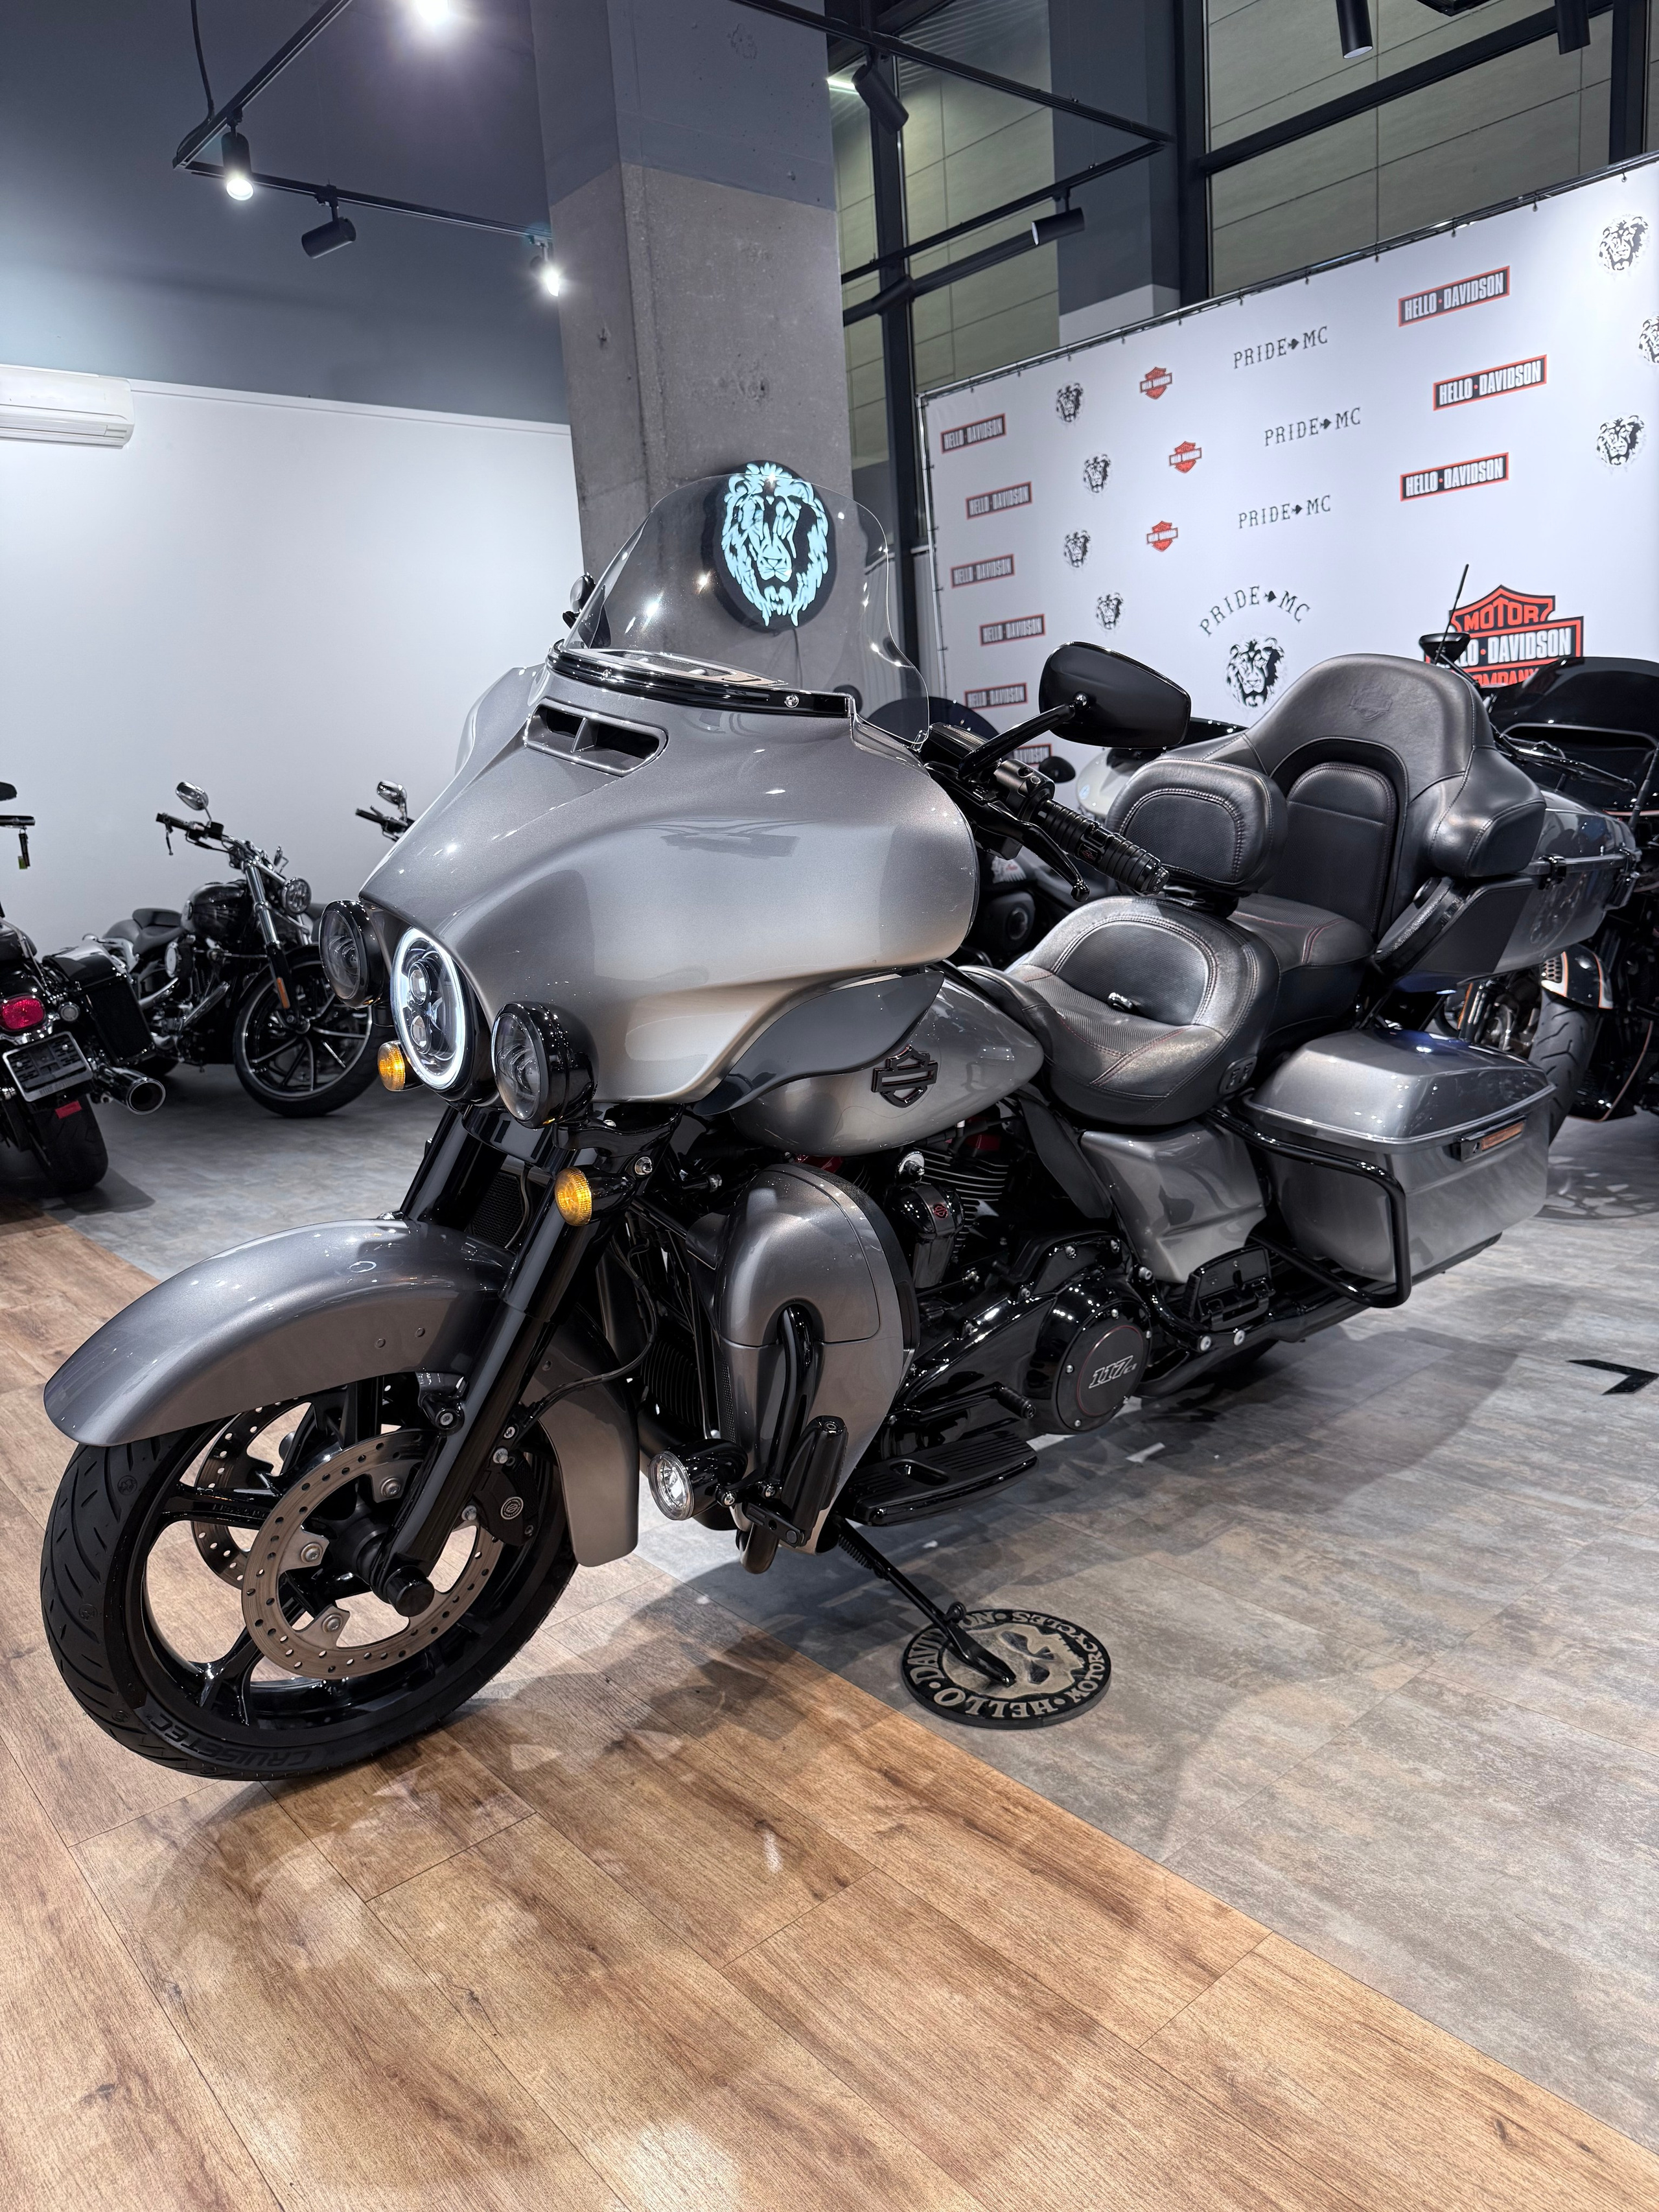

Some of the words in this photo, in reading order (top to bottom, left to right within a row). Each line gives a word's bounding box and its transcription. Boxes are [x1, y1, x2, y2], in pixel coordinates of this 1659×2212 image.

[1404, 292, 1437, 321] HELLO
[1443, 273, 1504, 310] DAVIDSON
[1233, 337, 1287, 369] PRIDE
[1303, 325, 1328, 350] MC
[1439, 377, 1473, 406] HELLO
[1479, 360, 1542, 396] DAVIDSON
[1264, 417, 1319, 447] PRIDE
[1335, 406, 1361, 430] MC
[1406, 471, 1439, 497] HELLO
[1443, 457, 1503, 489] DAVIDSON
[1238, 503, 1290, 530] PRIDE
[1306, 494, 1331, 517] MC
[1198, 585, 1260, 638] PRIDE
[1277, 590, 1311, 624] MC
[1463, 596, 1539, 632] MOTOR
[1487, 627, 1572, 664] DAVIDSON
[1012, 1611, 1106, 1703] MOTORCYCLES
[934, 1688, 1058, 1717] HELLO
